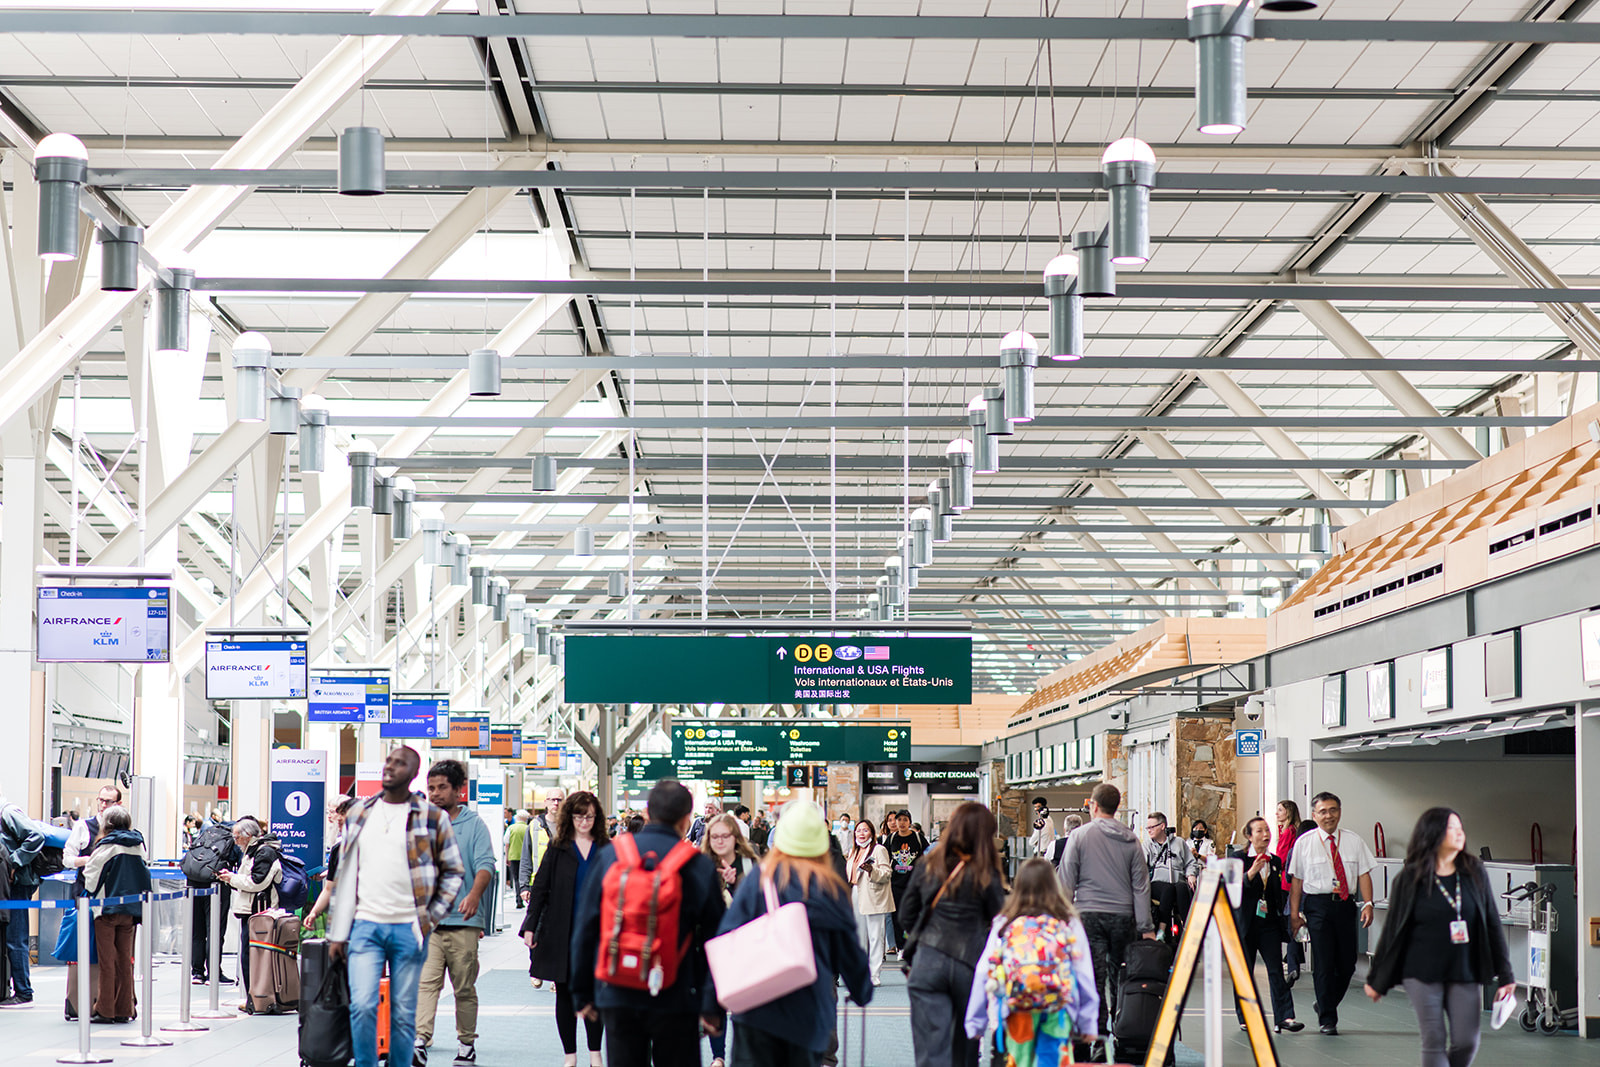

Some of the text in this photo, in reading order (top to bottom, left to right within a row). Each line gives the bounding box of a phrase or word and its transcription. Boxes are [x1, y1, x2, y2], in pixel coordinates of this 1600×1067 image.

[799, 648, 828, 658] D E
[794, 666, 924, 678] International & USA Flights
[794, 674, 954, 687] Vols internationaux et États-Unis
[794, 690, 850, 698] 美国及国际出发
[294, 796, 300, 811] 1
